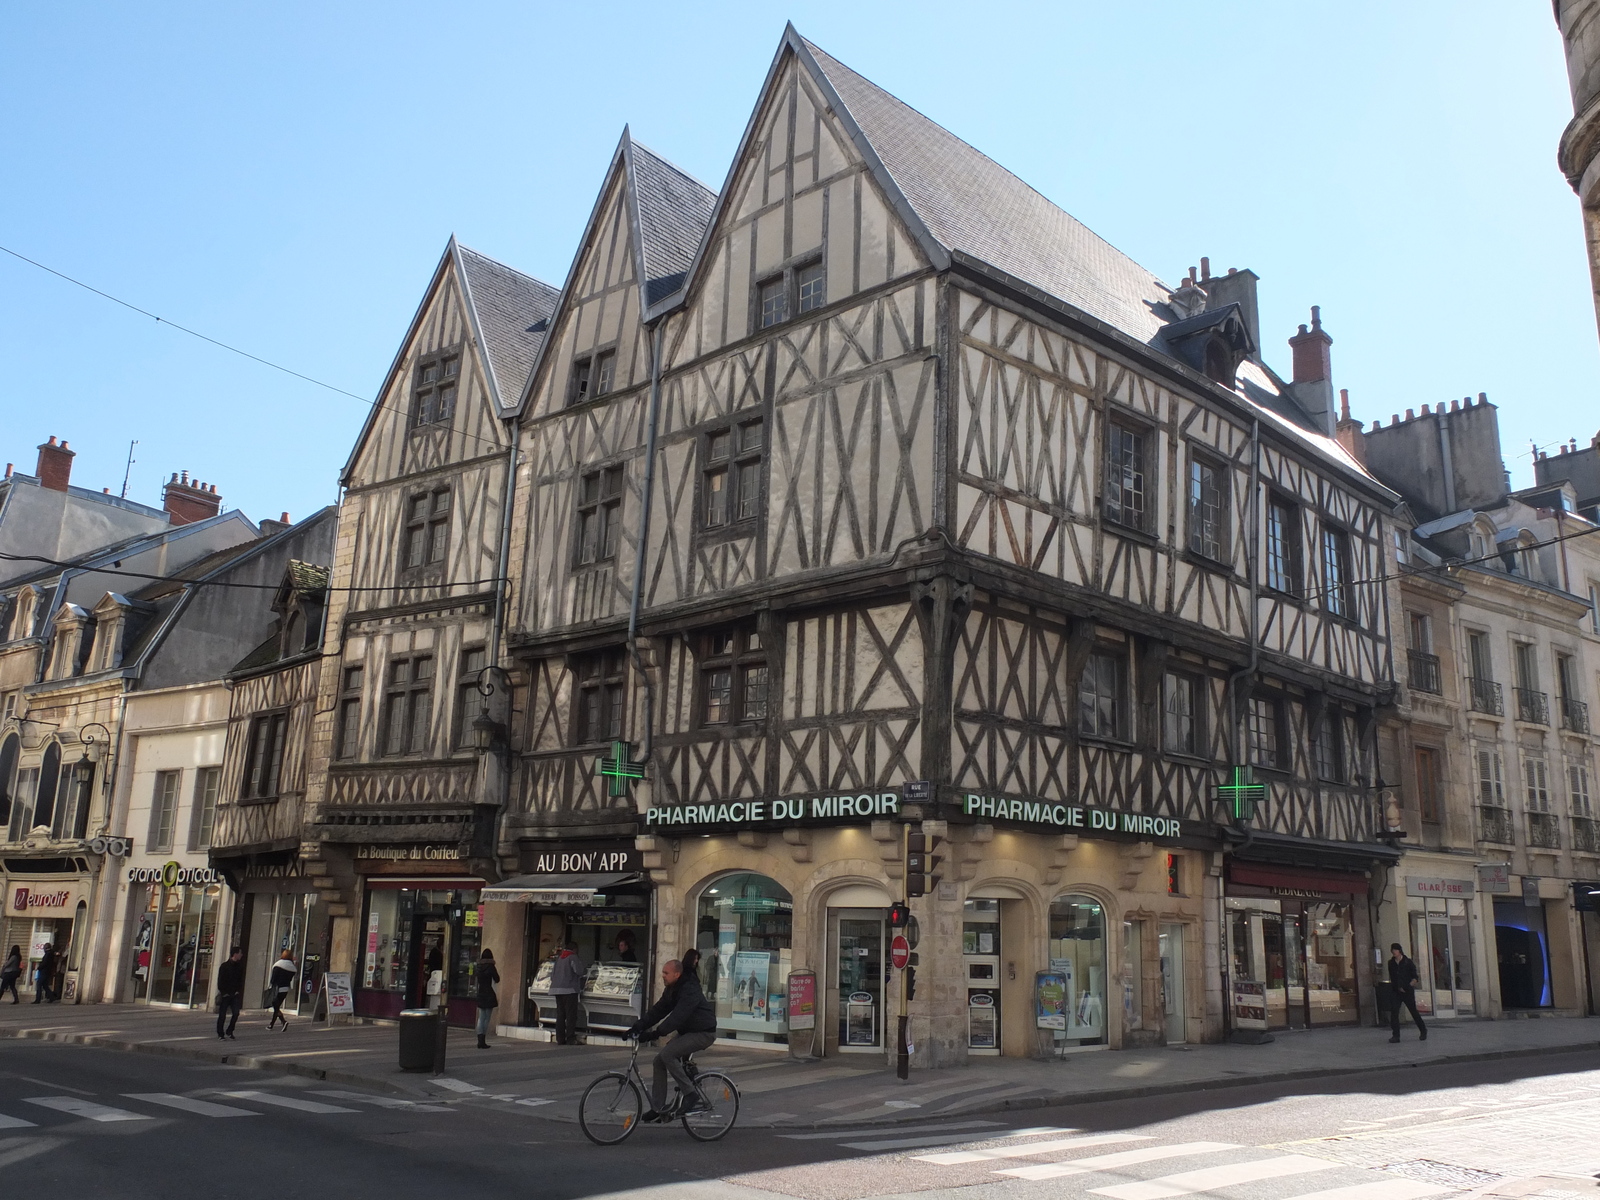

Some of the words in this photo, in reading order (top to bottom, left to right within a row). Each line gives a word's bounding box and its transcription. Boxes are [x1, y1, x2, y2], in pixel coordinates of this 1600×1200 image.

[646, 801, 764, 825] PHARMACIE
[772, 799, 804, 820] DU
[812, 793, 898, 818] MIROIR
[967, 794, 1084, 828] PHARMACIE
[1091, 809, 1117, 832] DU
[1123, 813, 1181, 838] MIROIR
[358, 846, 367, 858] La
[370, 845, 407, 862] Boutique
[410, 845, 421, 860] du
[424, 844, 460, 860] Coiffeu
[536, 854, 556, 872] AU
[27, 891, 70, 907] eurodif
